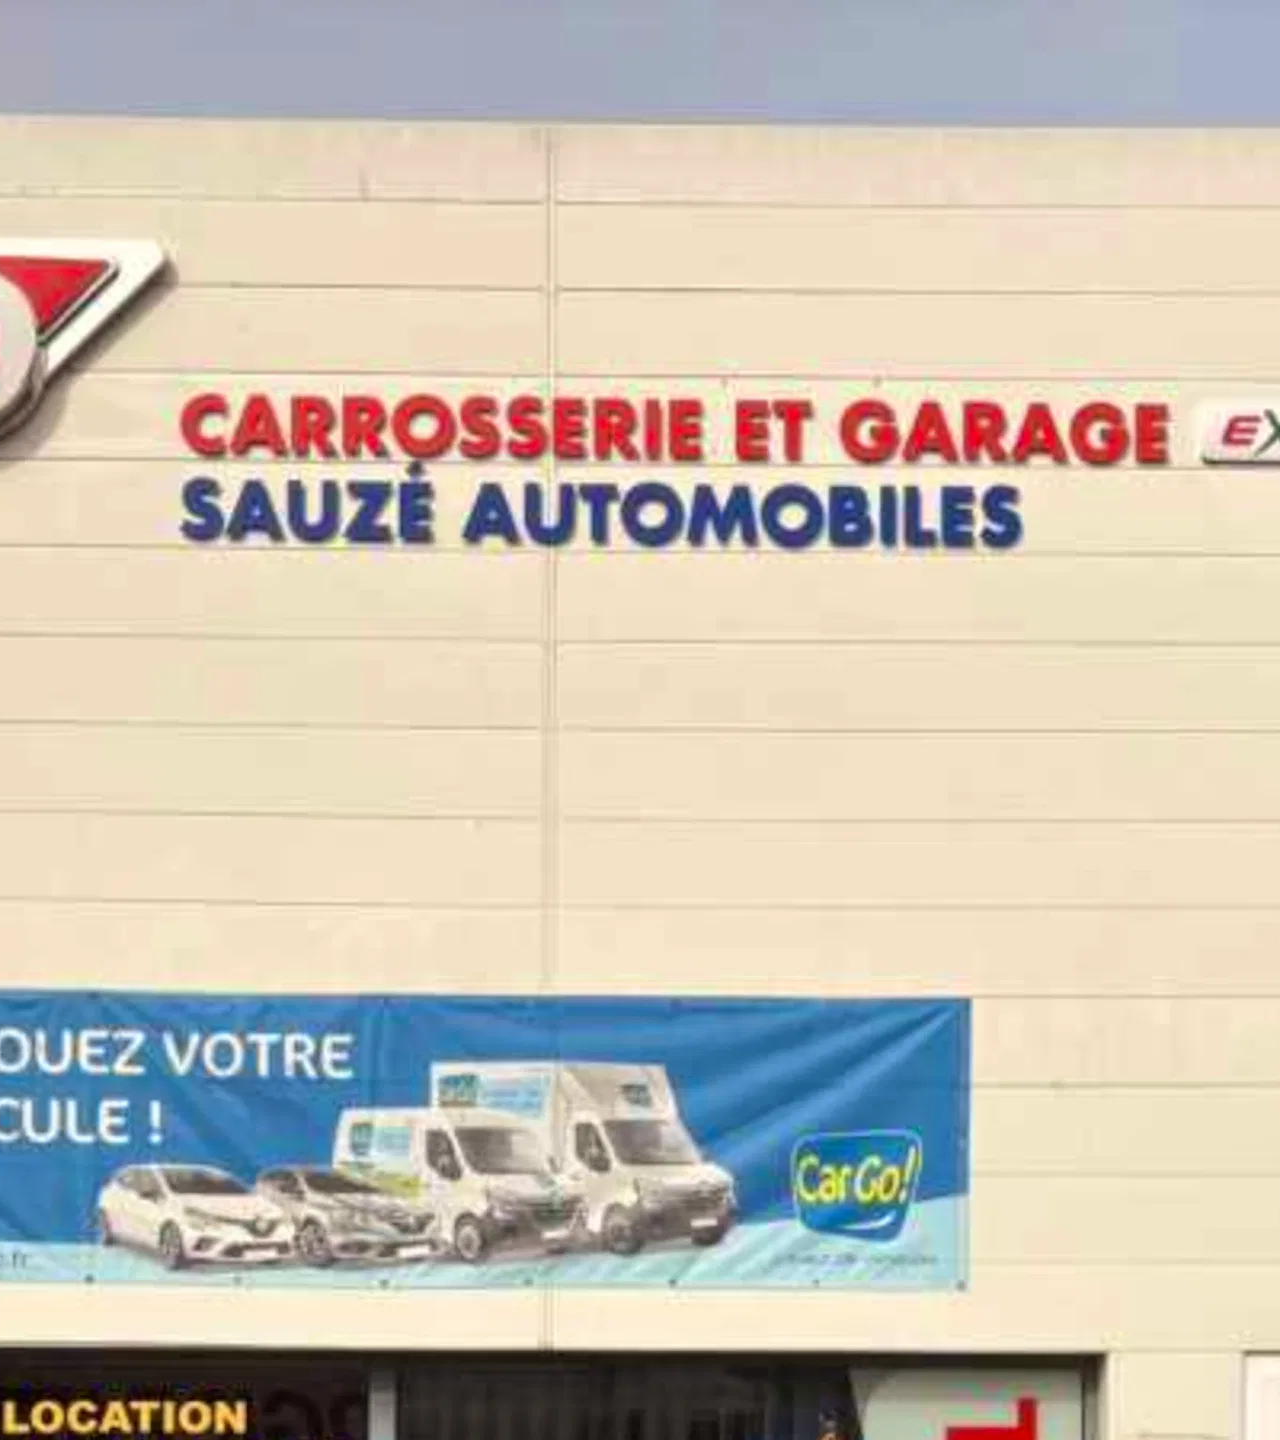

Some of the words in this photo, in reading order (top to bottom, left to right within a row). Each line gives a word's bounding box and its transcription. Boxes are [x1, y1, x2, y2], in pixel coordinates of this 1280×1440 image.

[180, 394, 703, 460] CARROSSERIE
[735, 399, 814, 462] ET
[839, 399, 1171, 465] GARAGE
[180, 461, 436, 545] SAUZÉ
[463, 484, 1024, 550] AUTOMOBILES
[161, 1033, 356, 1079] VOTRE
[149, 1100, 162, 1144] !
[1, 1400, 248, 1435] LOCATION
